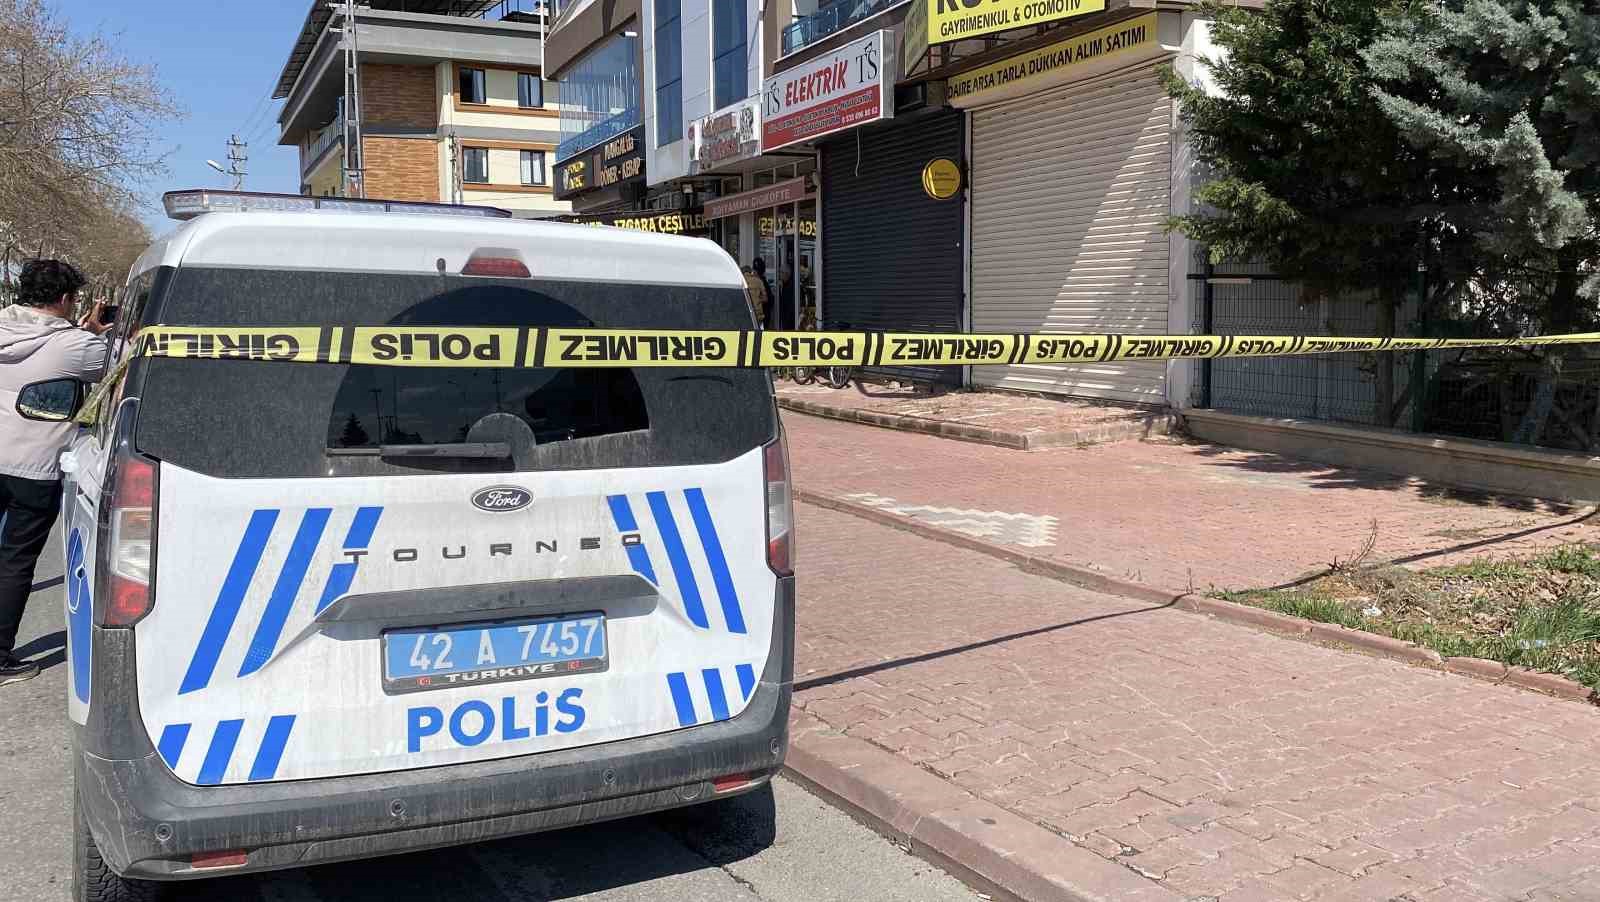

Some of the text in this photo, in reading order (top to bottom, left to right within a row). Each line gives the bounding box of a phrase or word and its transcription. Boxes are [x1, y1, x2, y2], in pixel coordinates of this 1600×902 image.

[940, 11, 1010, 37] GAYRİMENKUL
[1013, 8, 1020, 20] &
[973, 72, 995, 92] ARSA
[997, 62, 1026, 84] TARLA
[1029, 50, 1073, 77] DÜKKAN
[1076, 38, 1103, 60] ALIM
[1106, 24, 1146, 52] SATIMI
[785, 57, 849, 107] ELEKTRİK
[370, 333, 500, 361] POLİS
[559, 335, 726, 361] GİRİLMEZ
[772, 337, 854, 361] POLİS
[892, 338, 1004, 361] GİRİLMEZ
[1036, 340, 1099, 358] POLİS
[1124, 339, 1213, 357] GİRİLMEZ
[484, 489, 522, 507] Ford
[343, 533, 642, 565] TOURNEO
[409, 620, 599, 671] 42 A 7457
[407, 687, 586, 753] POLİS
